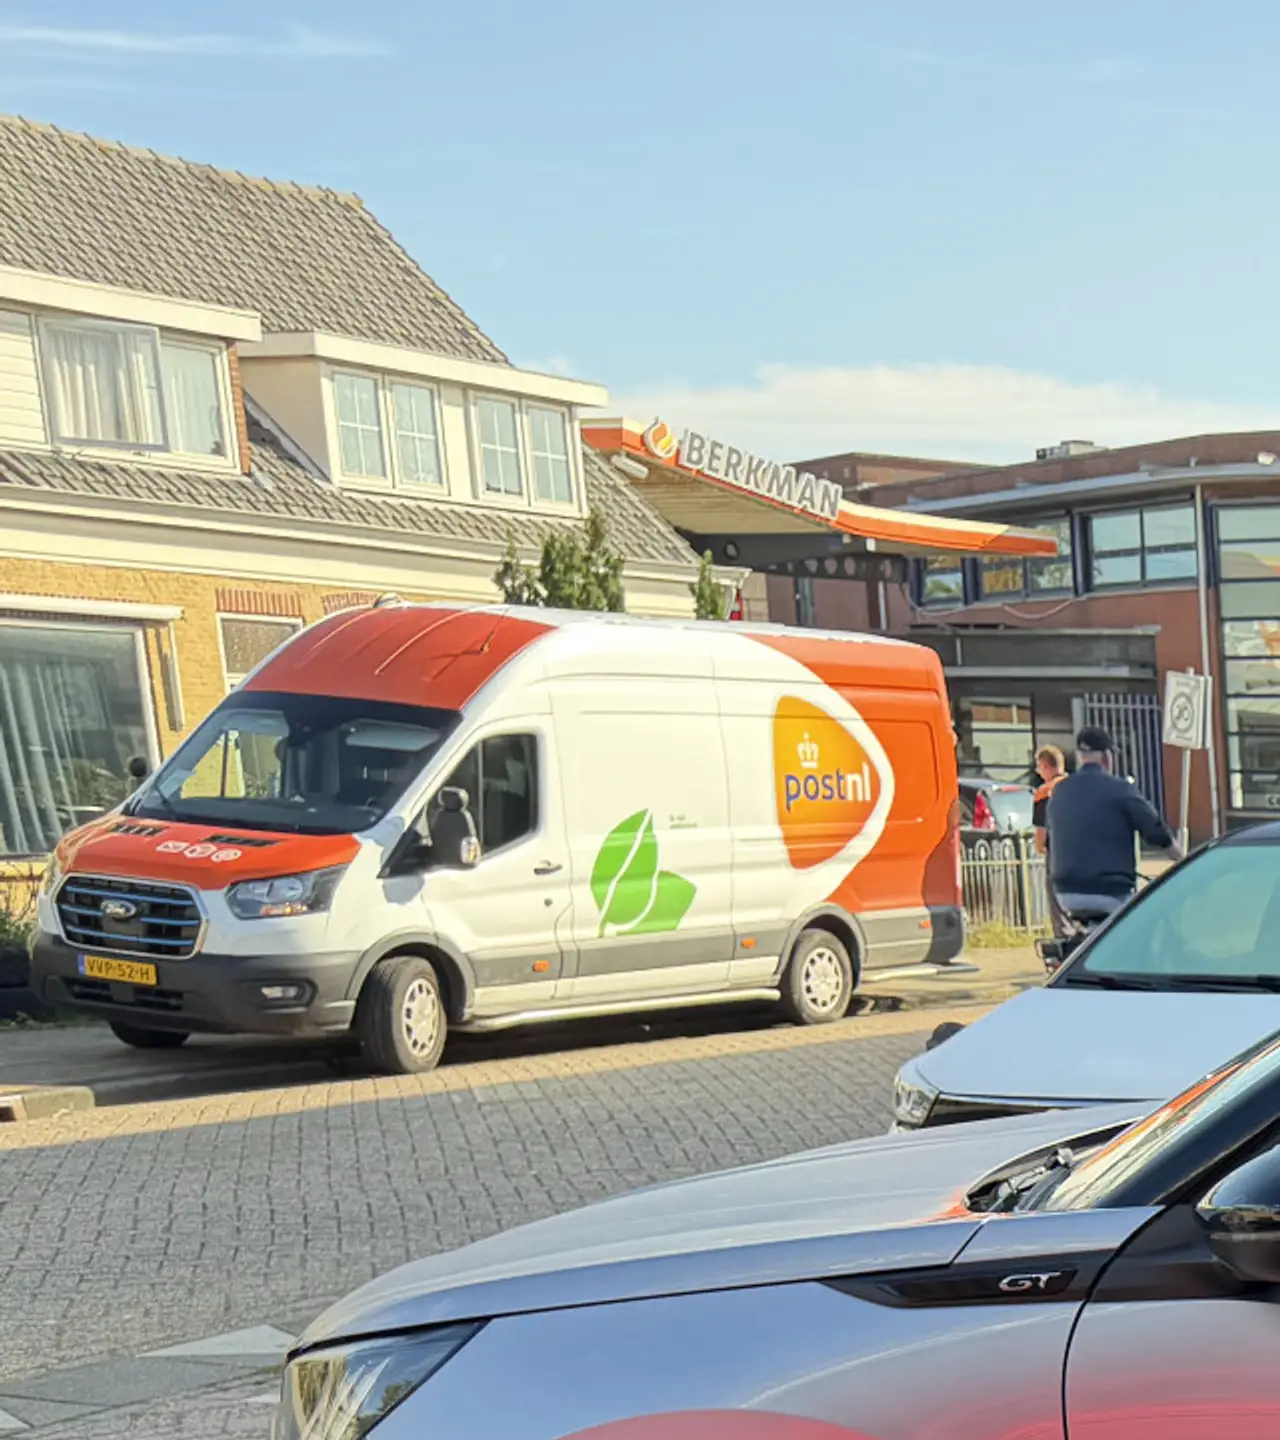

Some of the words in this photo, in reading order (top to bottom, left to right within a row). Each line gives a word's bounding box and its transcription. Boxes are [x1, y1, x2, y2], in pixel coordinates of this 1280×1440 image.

[684, 430, 842, 519] BERKMAN
[785, 761, 872, 814] postnl
[998, 1271, 1061, 1292] GT
